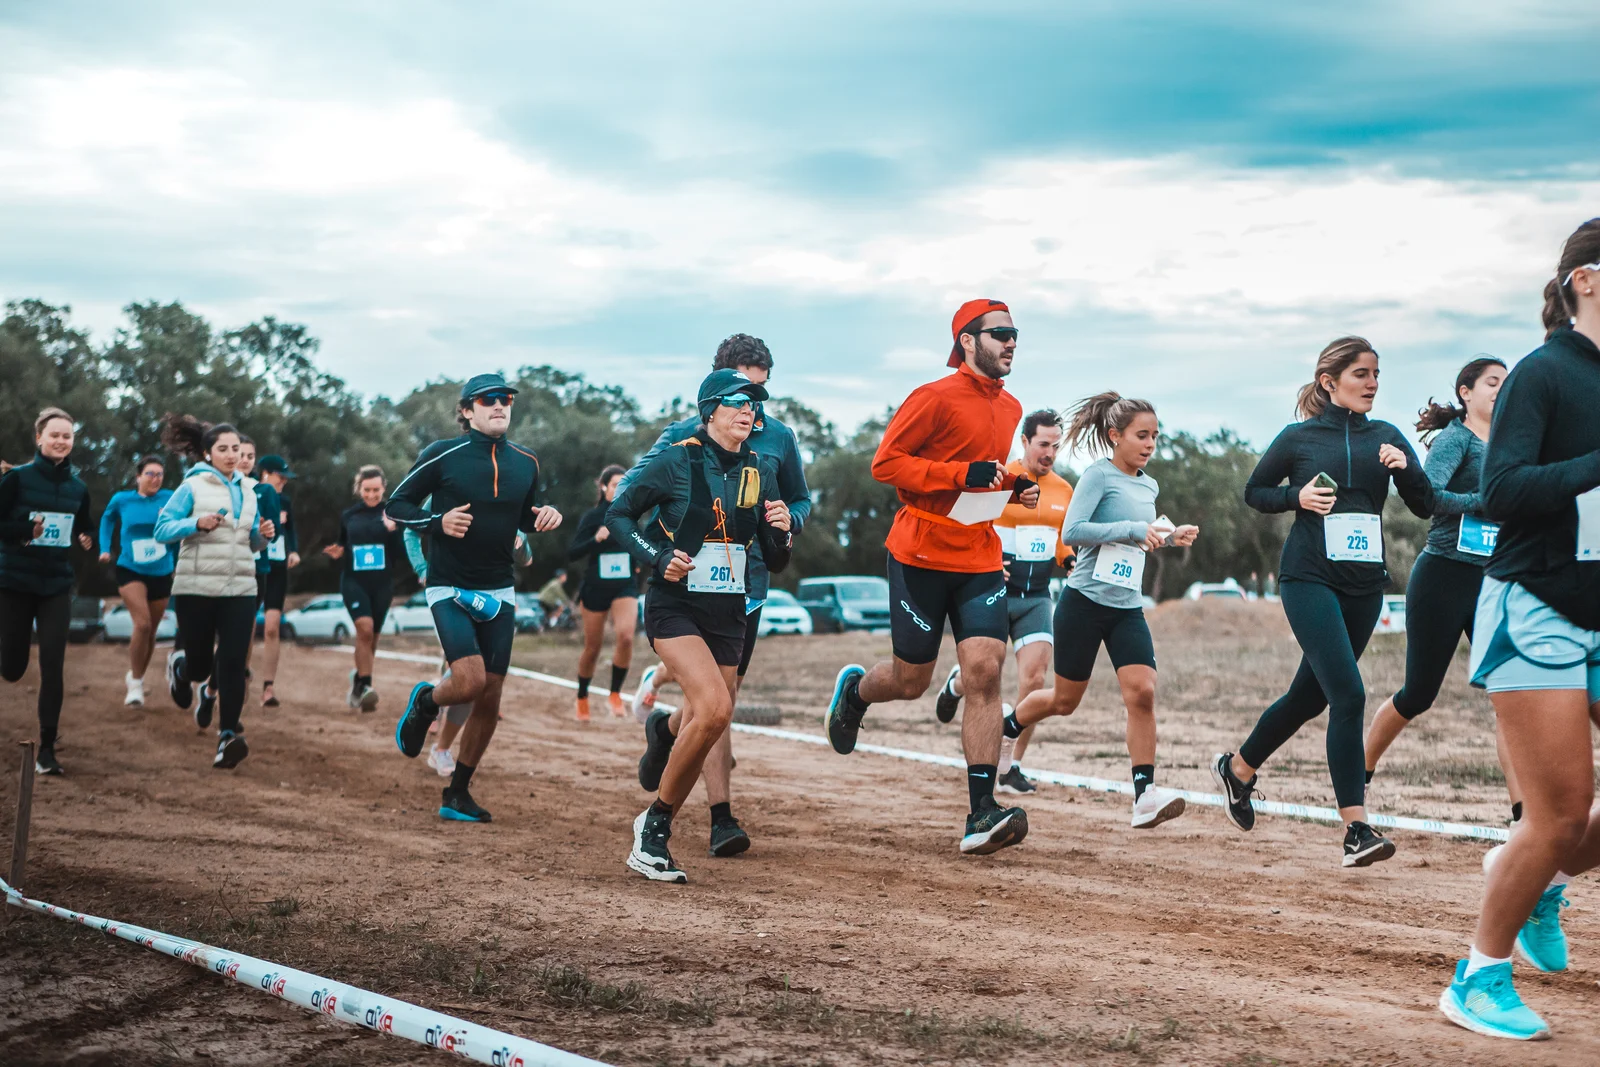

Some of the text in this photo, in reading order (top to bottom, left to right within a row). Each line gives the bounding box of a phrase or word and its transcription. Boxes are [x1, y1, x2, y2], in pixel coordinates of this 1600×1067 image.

[1030, 542, 1046, 552] 229
[1347, 535, 1368, 550] 225
[710, 565, 731, 581] 267
[1111, 562, 1133, 578] 239
